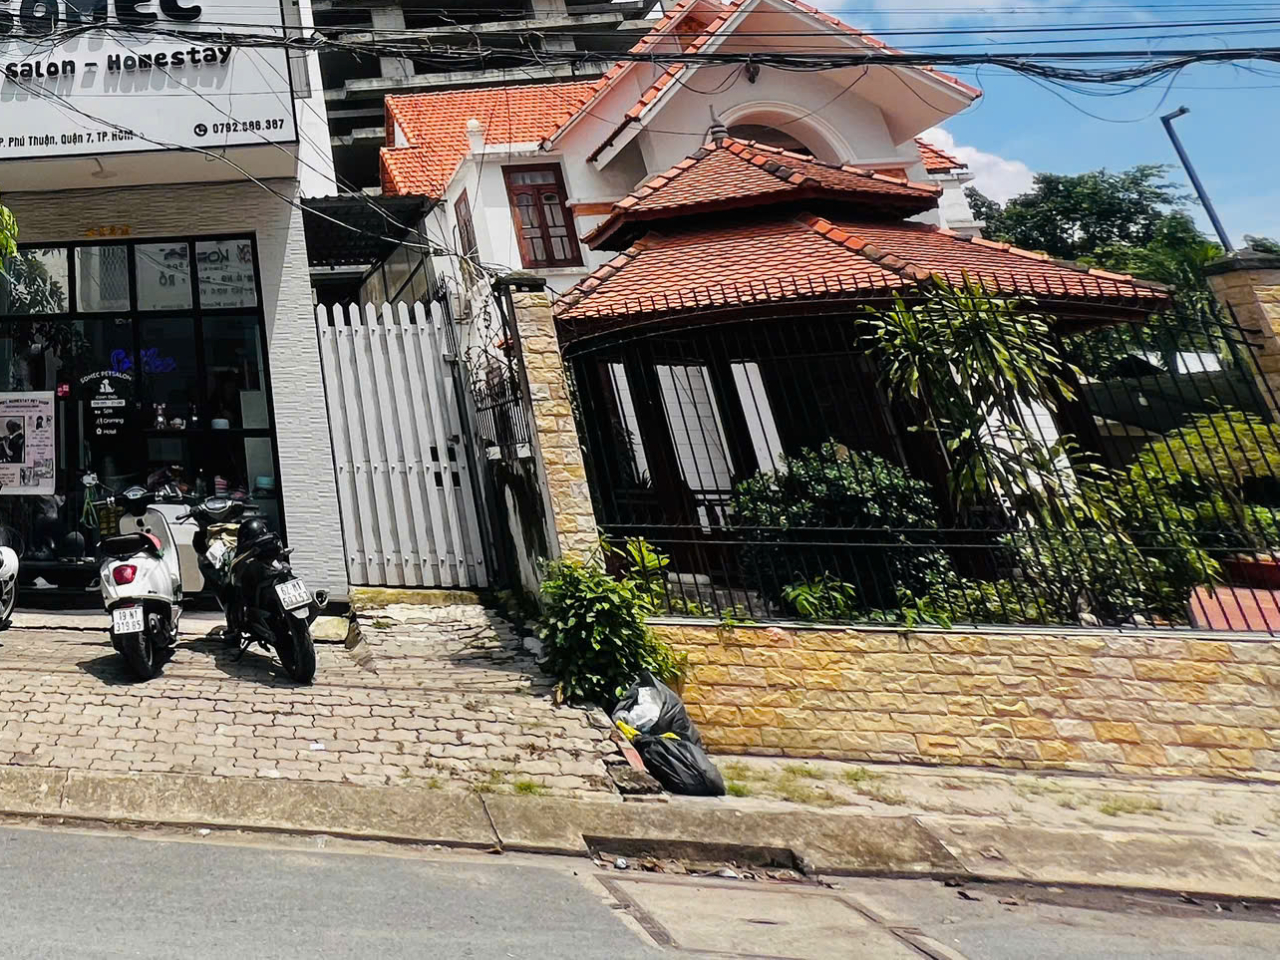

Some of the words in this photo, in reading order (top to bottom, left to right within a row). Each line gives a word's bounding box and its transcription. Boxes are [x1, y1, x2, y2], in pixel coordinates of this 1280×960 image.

[5, 59, 76, 82] Salon
[107, 46, 232, 76] Homestay
[8, 135, 25, 148] Phú
[28, 133, 58, 147] Thuận,
[60, 132, 84, 146] Quận
